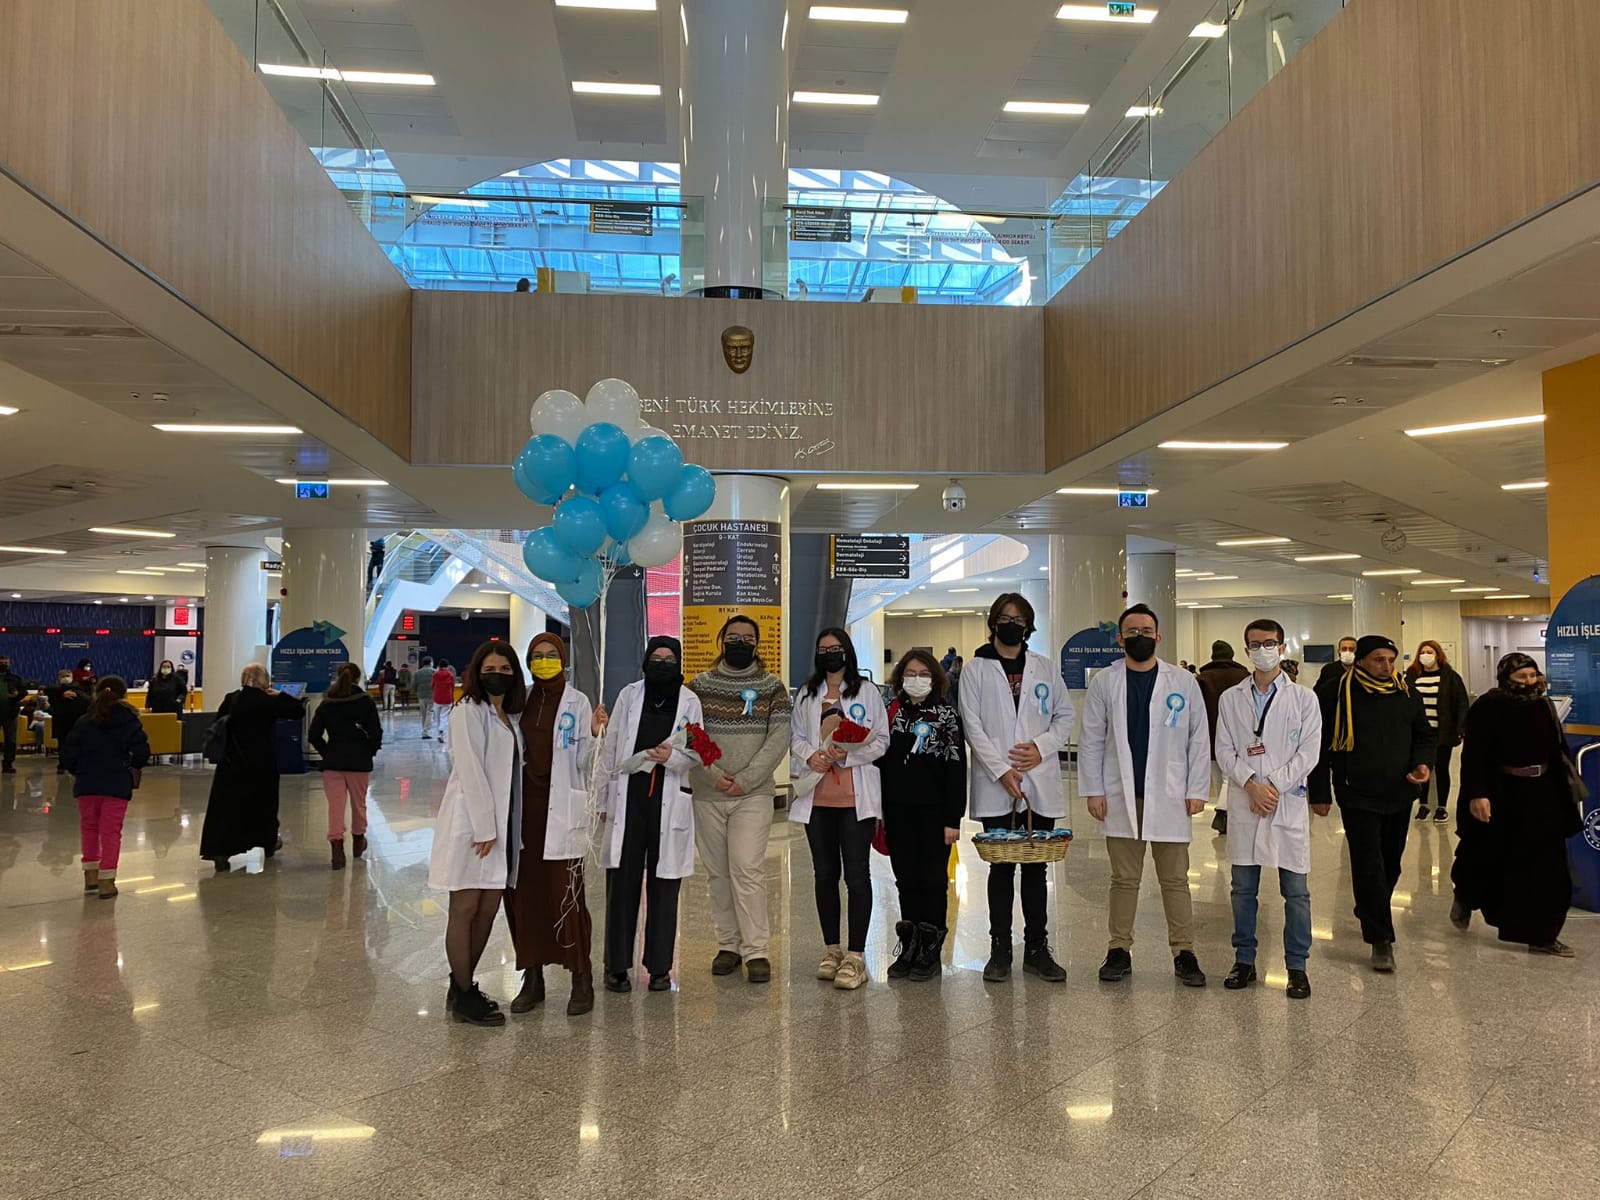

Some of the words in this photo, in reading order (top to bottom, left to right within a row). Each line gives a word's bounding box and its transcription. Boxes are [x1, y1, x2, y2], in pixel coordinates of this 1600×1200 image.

[675, 396, 721, 413] TÜRK
[727, 398, 833, 416] HEKİMLERİNE
[672, 424, 742, 439] EMANET
[746, 423, 803, 439] EDİNİZ.
[693, 523, 719, 533] ÇOCUK
[720, 523, 768, 532] HASTANESİ
[1557, 625, 1579, 637] HIZLI
